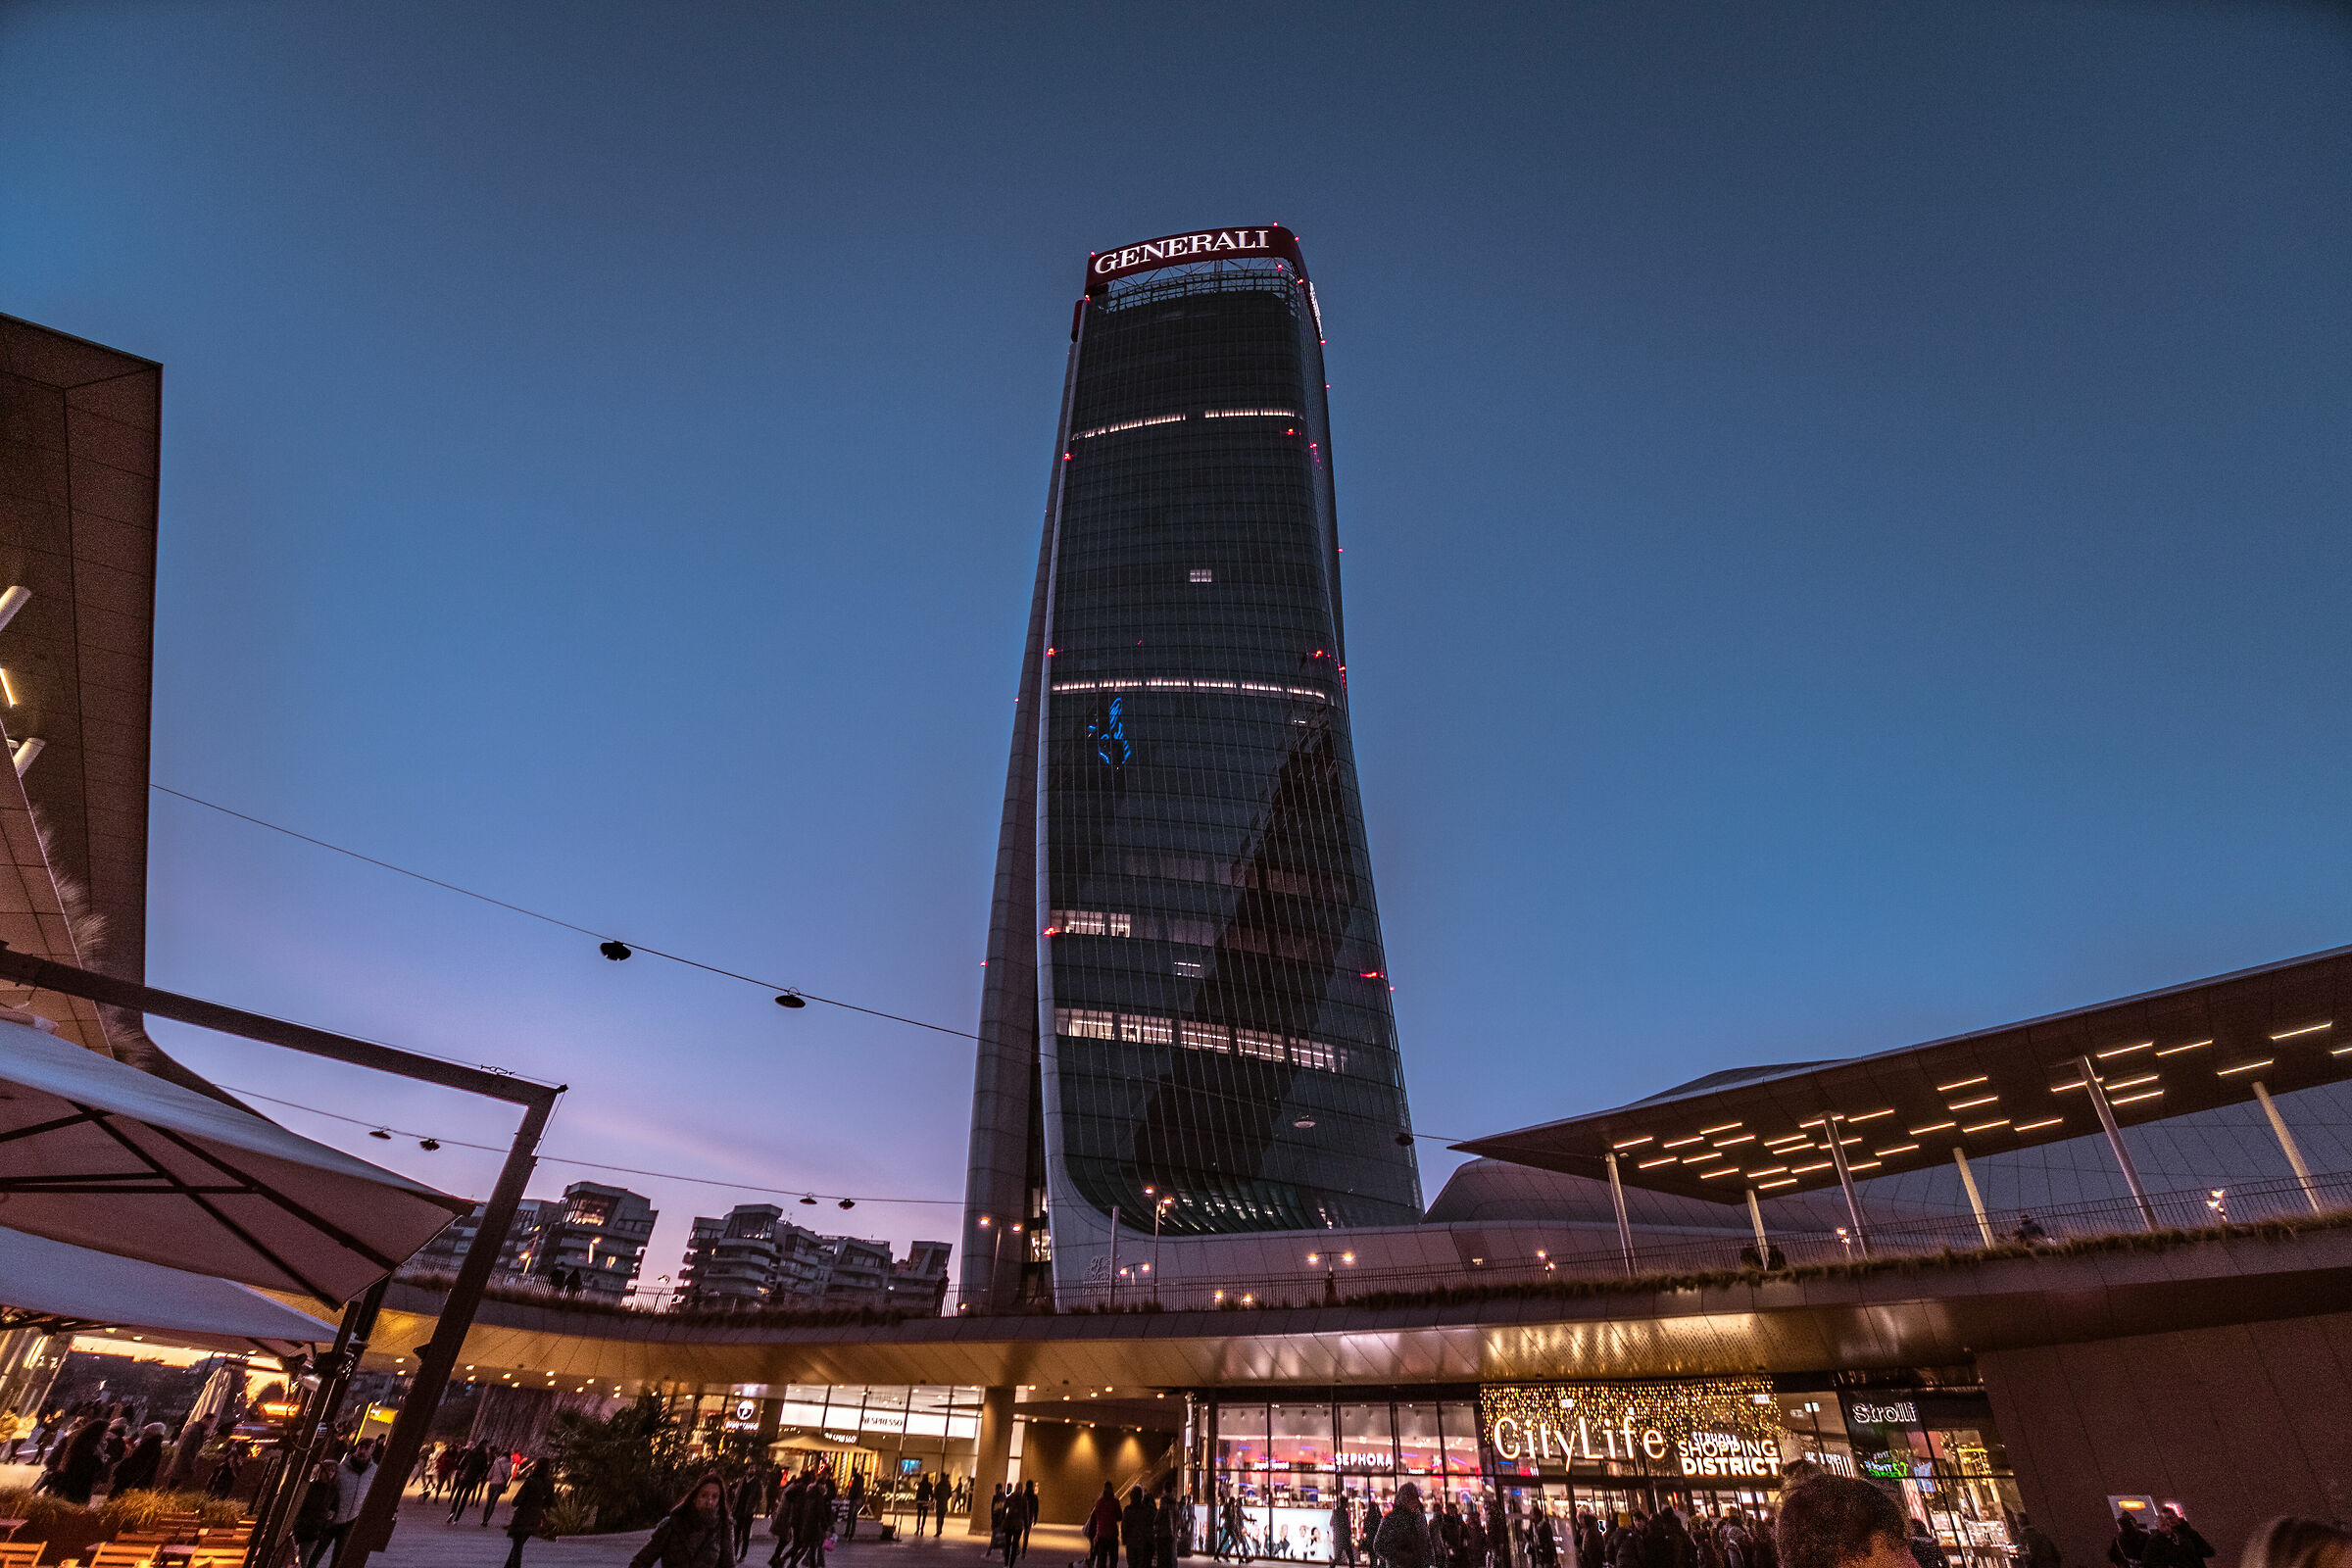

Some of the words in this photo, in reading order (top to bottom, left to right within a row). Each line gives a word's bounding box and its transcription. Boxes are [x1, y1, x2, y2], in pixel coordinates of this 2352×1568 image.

[1095, 229, 1270, 274] GENERALI
[1494, 1416, 1666, 1472] CityLife
[1678, 1439, 1779, 1458] SHOPPING
[1335, 1451, 1395, 1467] SEPHORA
[1681, 1456, 1781, 1478] DISTRICT
